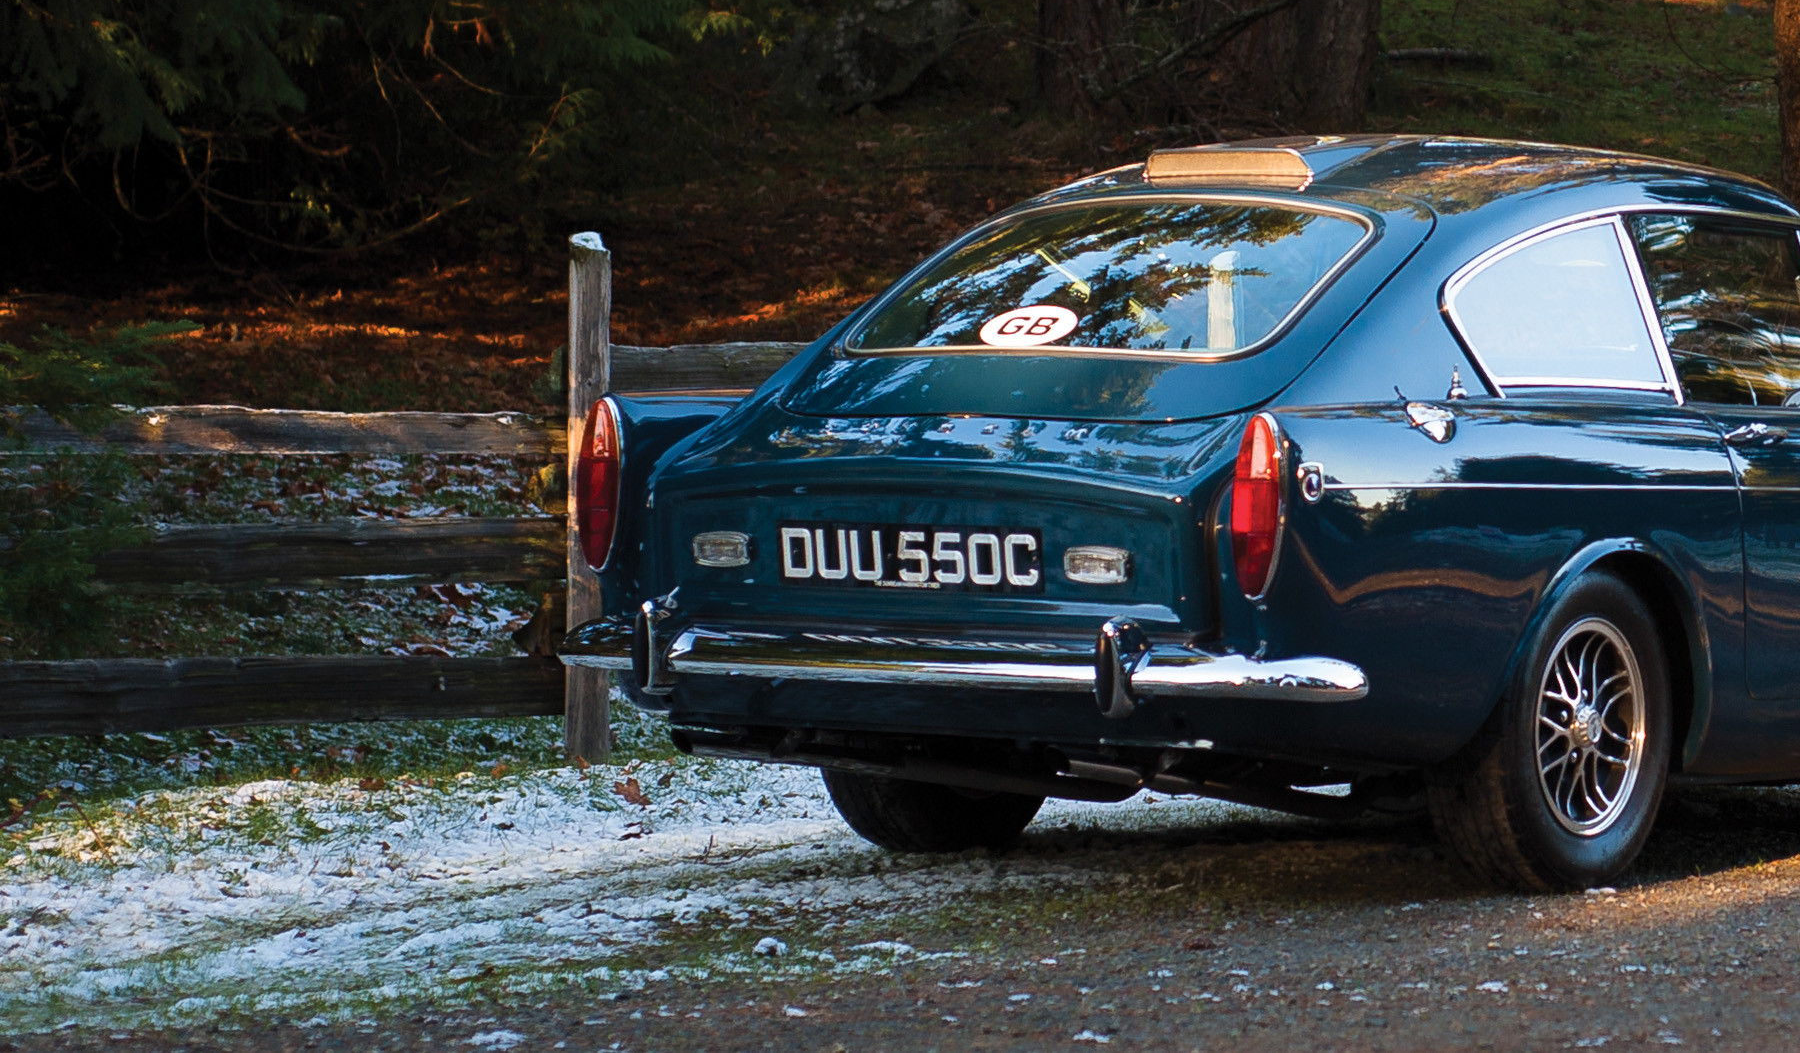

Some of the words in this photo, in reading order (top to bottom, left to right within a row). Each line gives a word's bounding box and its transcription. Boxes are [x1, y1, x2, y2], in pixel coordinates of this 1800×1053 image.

[997, 316, 1060, 336] GB
[781, 527, 883, 581] DUU
[897, 530, 1039, 586] 550C
